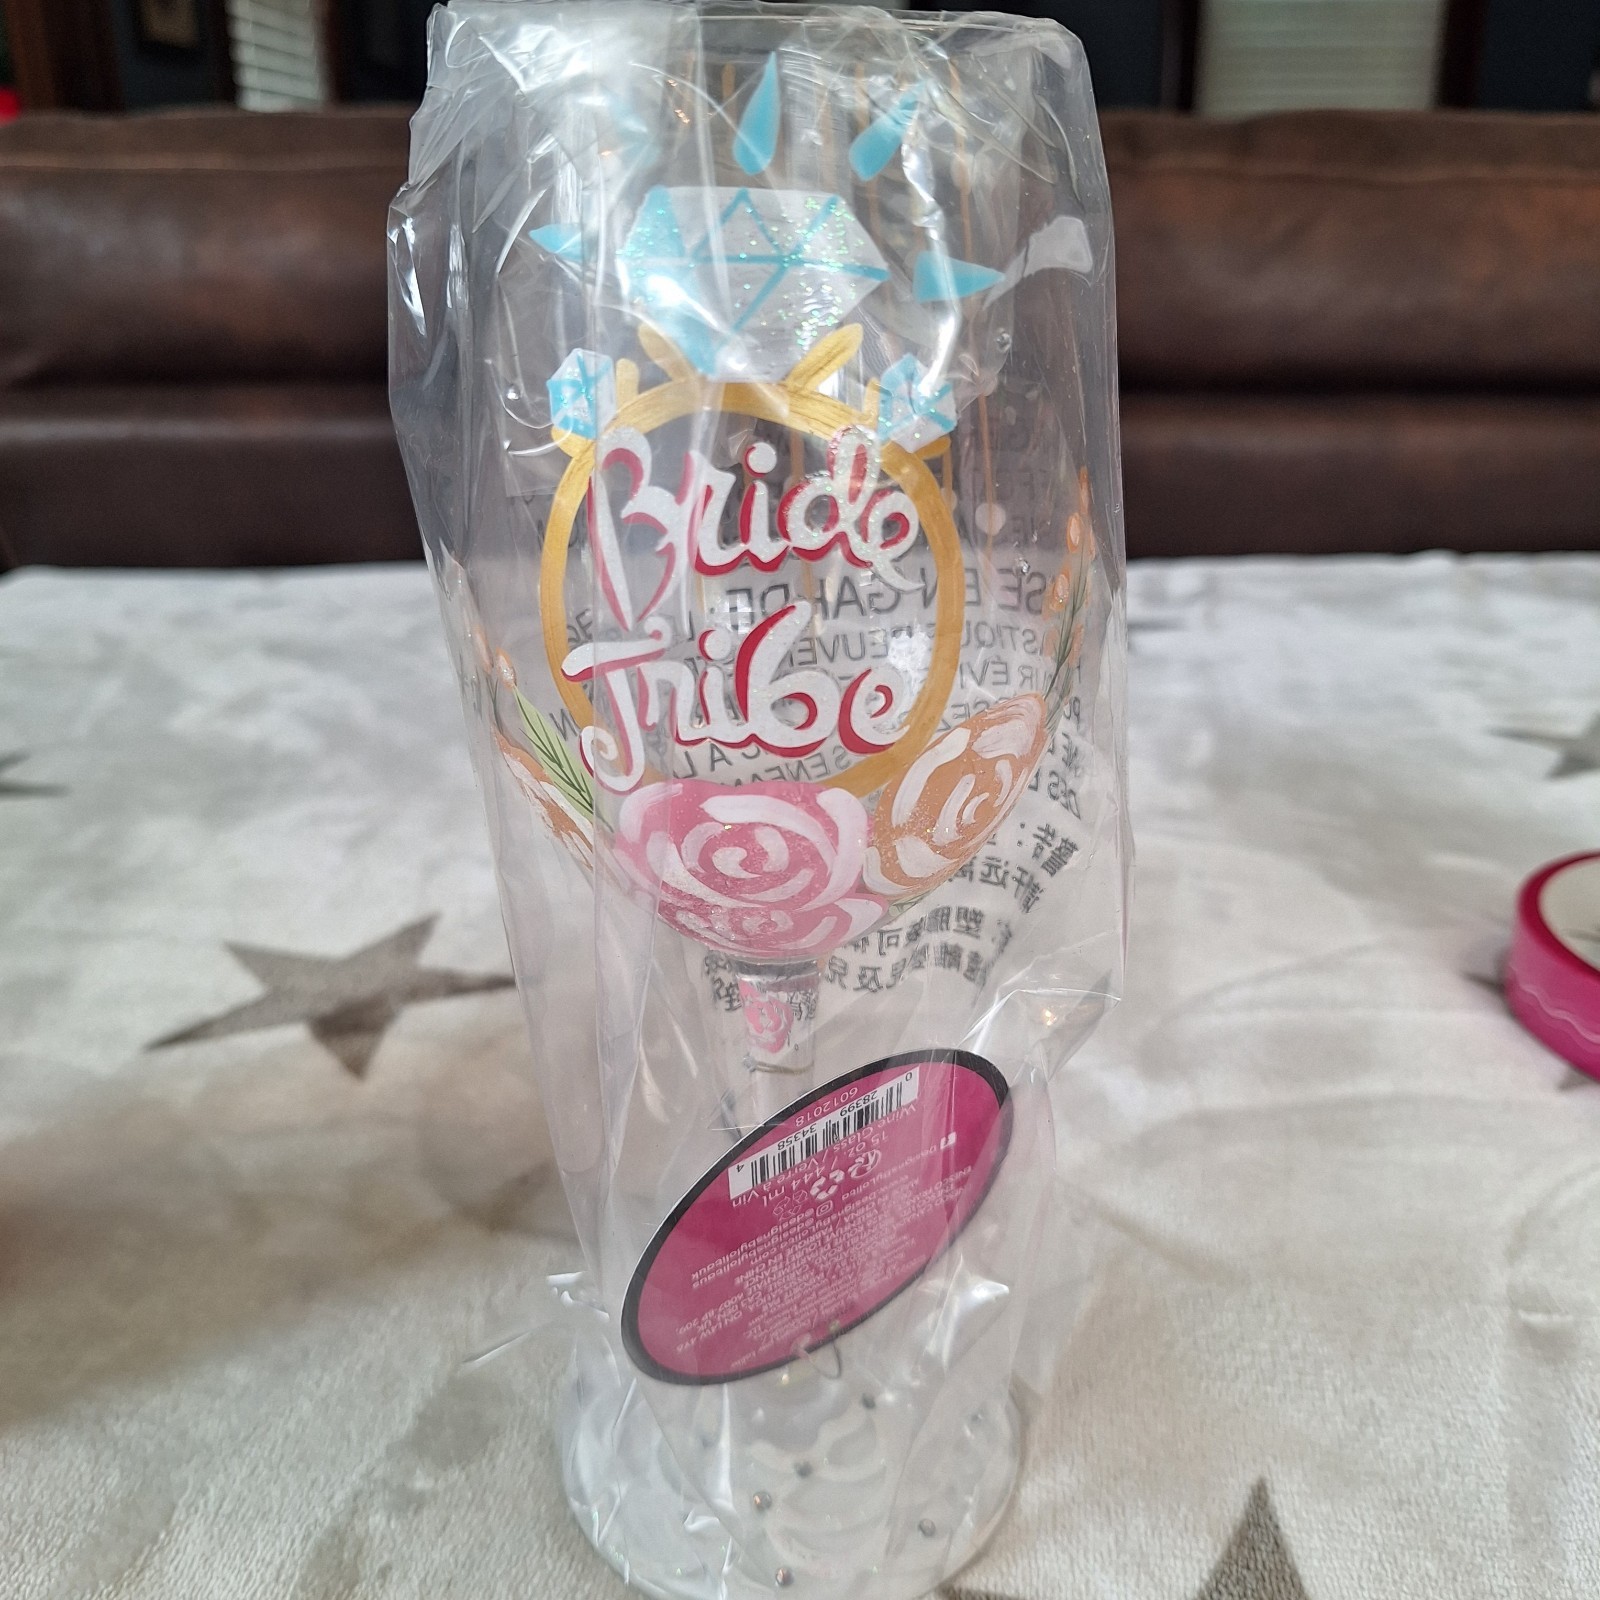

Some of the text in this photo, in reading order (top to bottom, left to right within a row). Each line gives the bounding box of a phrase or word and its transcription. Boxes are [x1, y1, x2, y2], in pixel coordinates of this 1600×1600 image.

[587, 424, 925, 632] Bride
[561, 601, 910, 792] Tribe
[795, 1088, 857, 1126] 6012018
[877, 1100, 915, 1130] Wine
[735, 1071, 912, 1173] 0 28399 34358 4
[833, 1124, 873, 1155] Glass
[843, 1140, 865, 1161] oz.
[870, 1128, 887, 1147] 15
[776, 1156, 818, 1185] Verre
[790, 1163, 824, 1191] 444
[731, 1187, 759, 1210] Vin
[761, 1185, 784, 1207] ml
